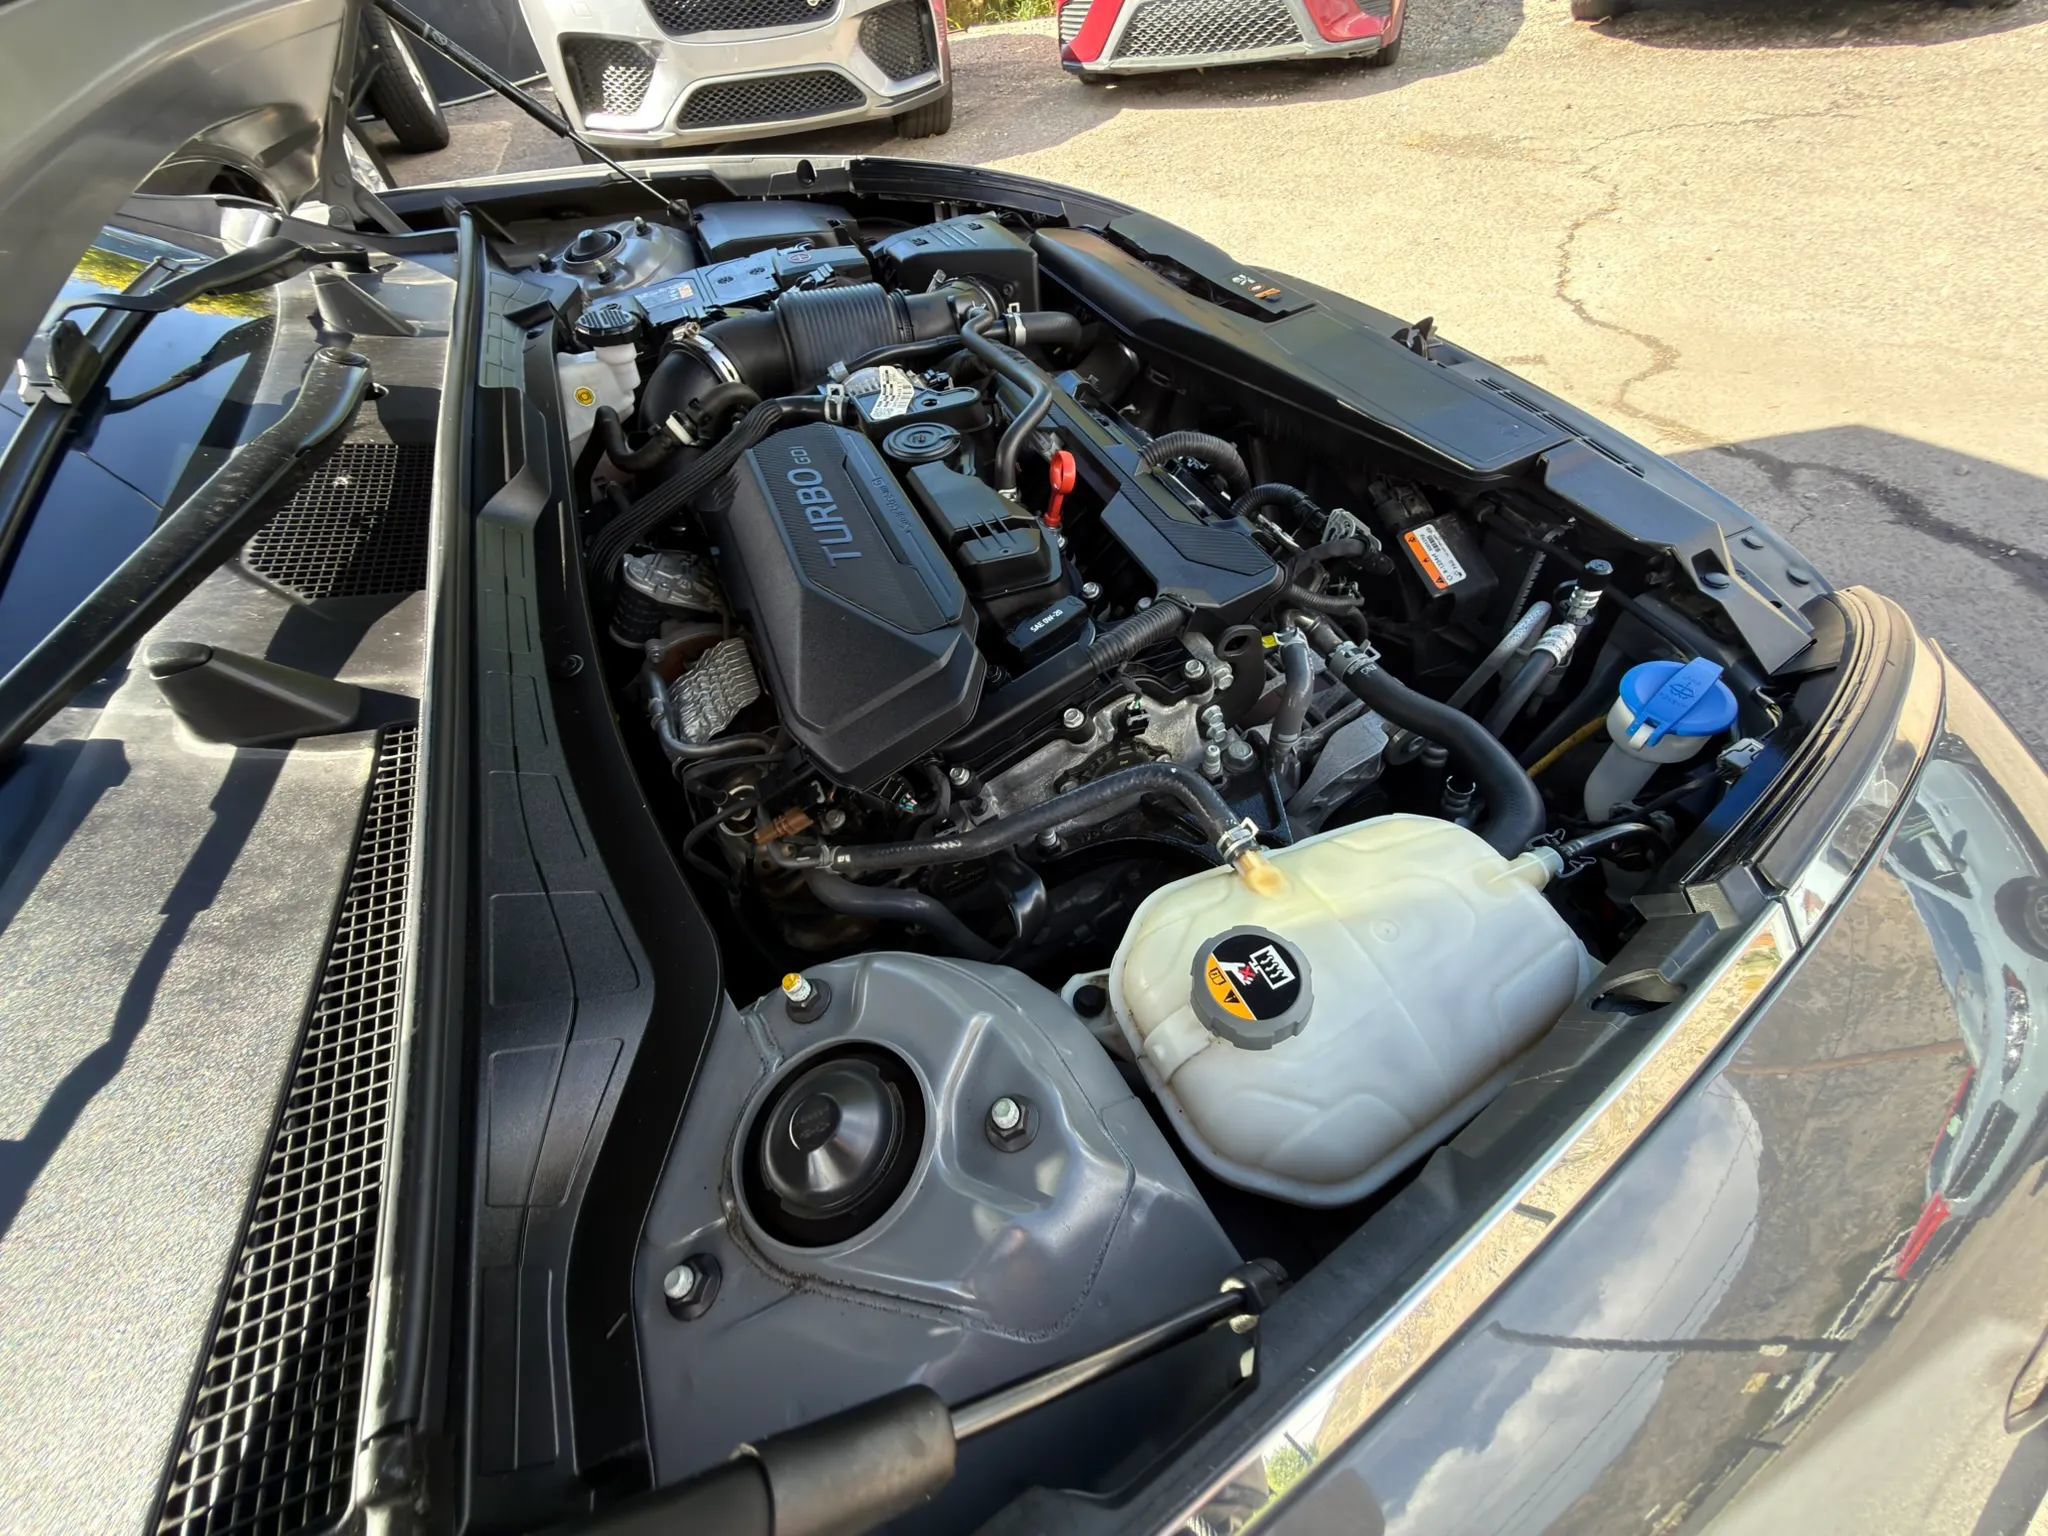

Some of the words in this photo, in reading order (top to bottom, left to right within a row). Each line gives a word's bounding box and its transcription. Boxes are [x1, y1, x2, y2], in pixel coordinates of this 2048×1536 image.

[789, 446, 811, 464] GDI
[787, 468, 863, 568] TURBO
[1030, 621, 1045, 632] SAE
[1042, 609, 1063, 625] 0W-20
